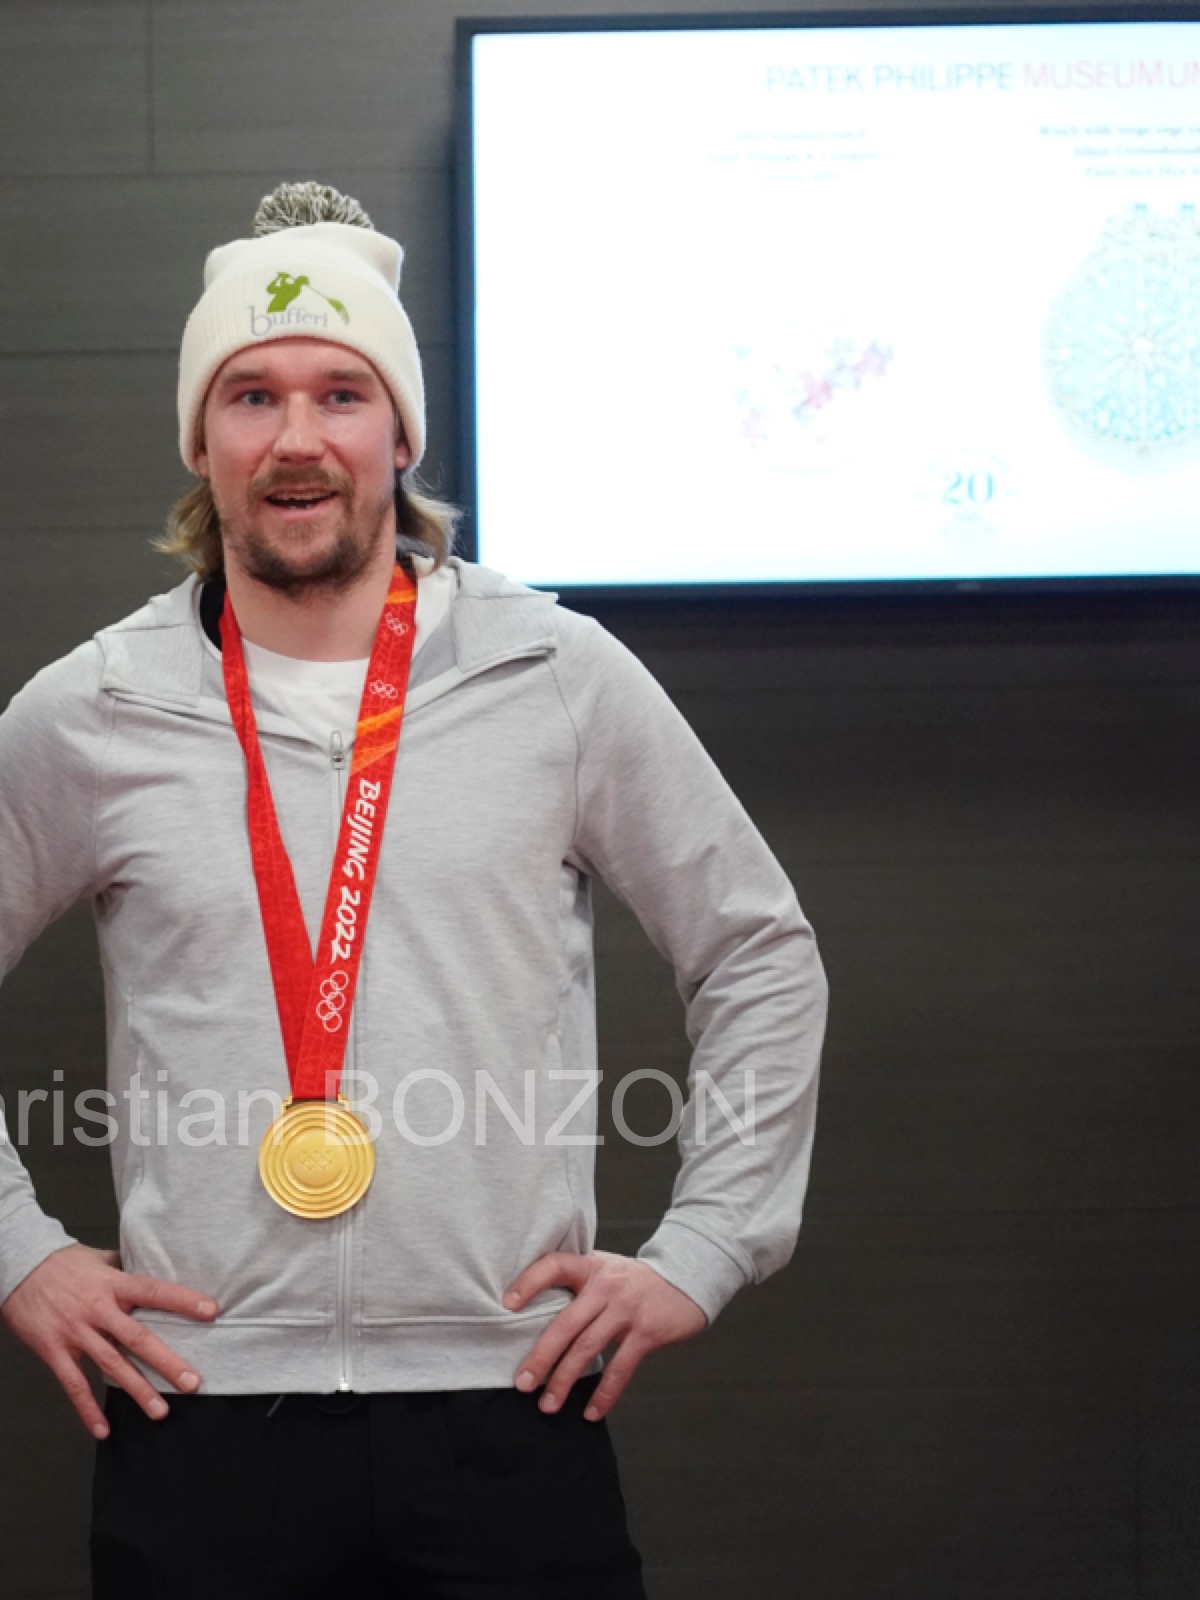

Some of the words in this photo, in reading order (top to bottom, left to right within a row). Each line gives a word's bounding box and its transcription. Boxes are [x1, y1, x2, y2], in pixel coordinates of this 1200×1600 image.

[764, 64, 865, 93] PATEK
[873, 61, 1014, 92] PHILIPPE
[1023, 59, 1163, 90] MUSEUM
[940, 469, 996, 506] 20
[341, 777, 382, 882] BEIJING
[330, 889, 362, 964] 2022
